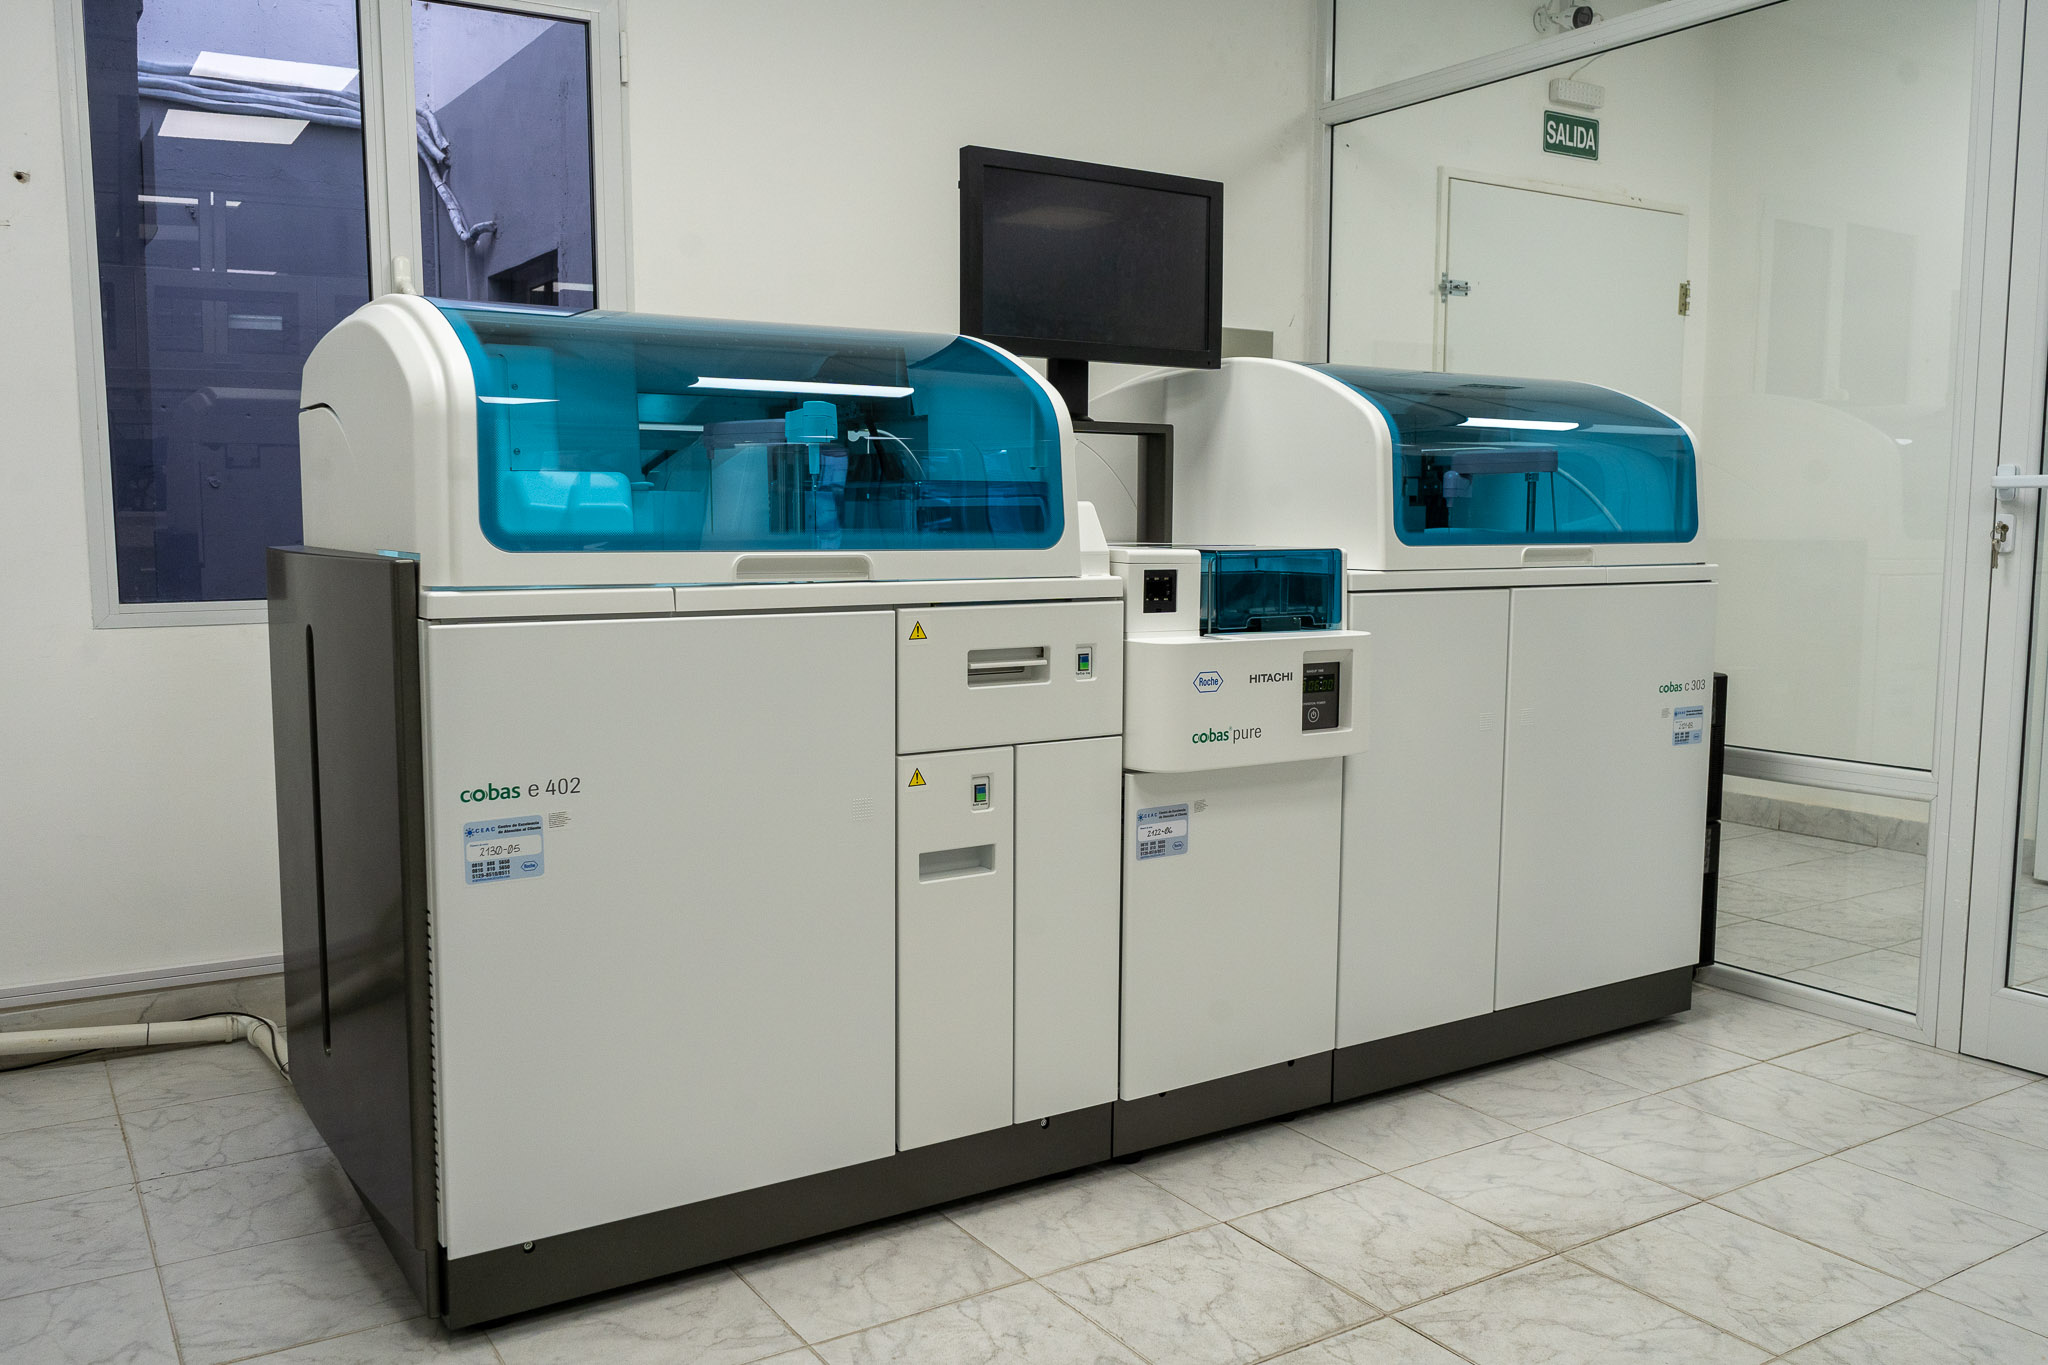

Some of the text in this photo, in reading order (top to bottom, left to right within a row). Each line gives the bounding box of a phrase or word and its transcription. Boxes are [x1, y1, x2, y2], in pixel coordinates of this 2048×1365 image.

[1546, 120, 1596, 151] SALIDA
[1198, 676, 1219, 687] Roche
[1249, 672, 1294, 684] HITACHI
[1659, 679, 1706, 694] cobas c 303
[1233, 727, 1262, 744] pure
[460, 777, 581, 803] cobas e 402
[479, 844, 521, 857] 2130-05
